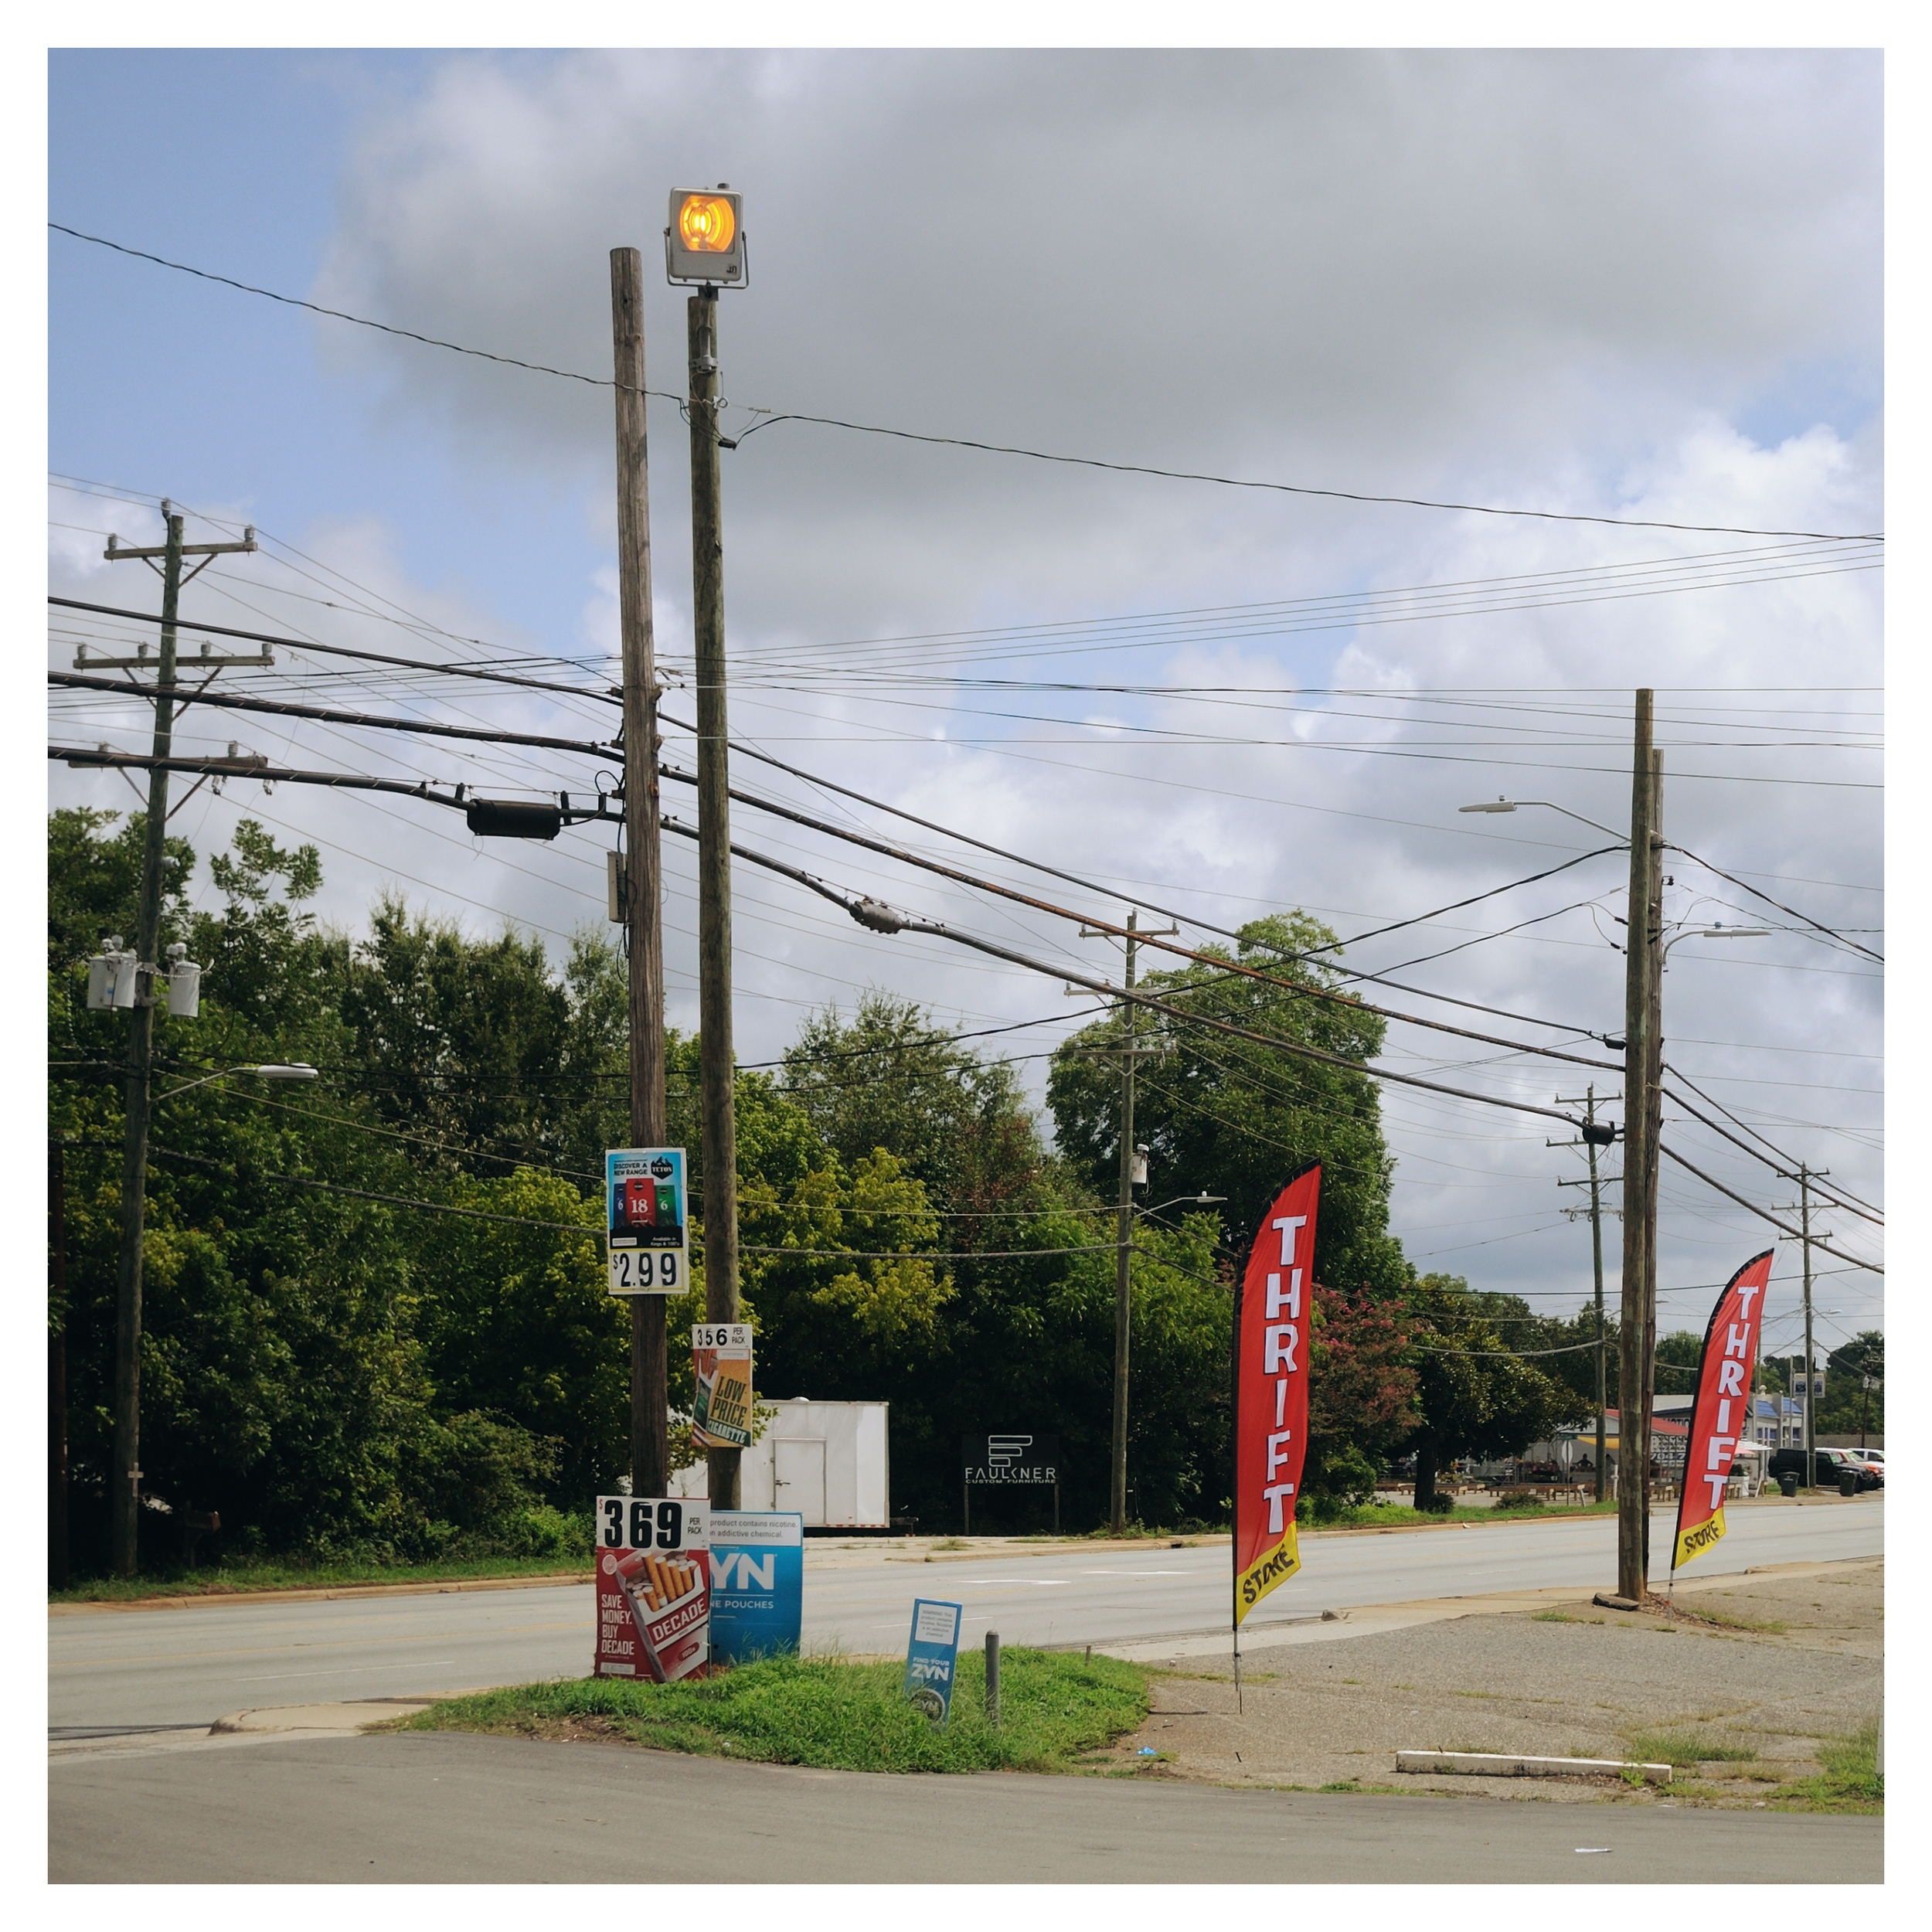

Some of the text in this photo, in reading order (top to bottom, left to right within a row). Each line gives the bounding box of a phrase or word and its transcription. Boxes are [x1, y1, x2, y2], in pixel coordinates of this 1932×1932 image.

[617, 1199, 624, 1210] 6
[631, 1199, 648, 1213] 18
[660, 1199, 668, 1211] 6
[1263, 1215, 1308, 1534] THRIFT
[716, 1376, 747, 1403] LOW
[1703, 1286, 1759, 1510] THRIFT
[710, 1396, 747, 1427] PRICE
[708, 1420, 747, 1444] CIGARETTE
[964, 1468, 1056, 1479] FAULKNER
[601, 1594, 622, 1609] SAVE
[725, 1600, 774, 1609] POUCHES
[602, 1610, 632, 1624] MONEY.
[652, 1597, 706, 1641] DECADE
[602, 1625, 618, 1638] BUY
[601, 1639, 634, 1655] DECADE
[911, 1663, 950, 1681] ZYN
